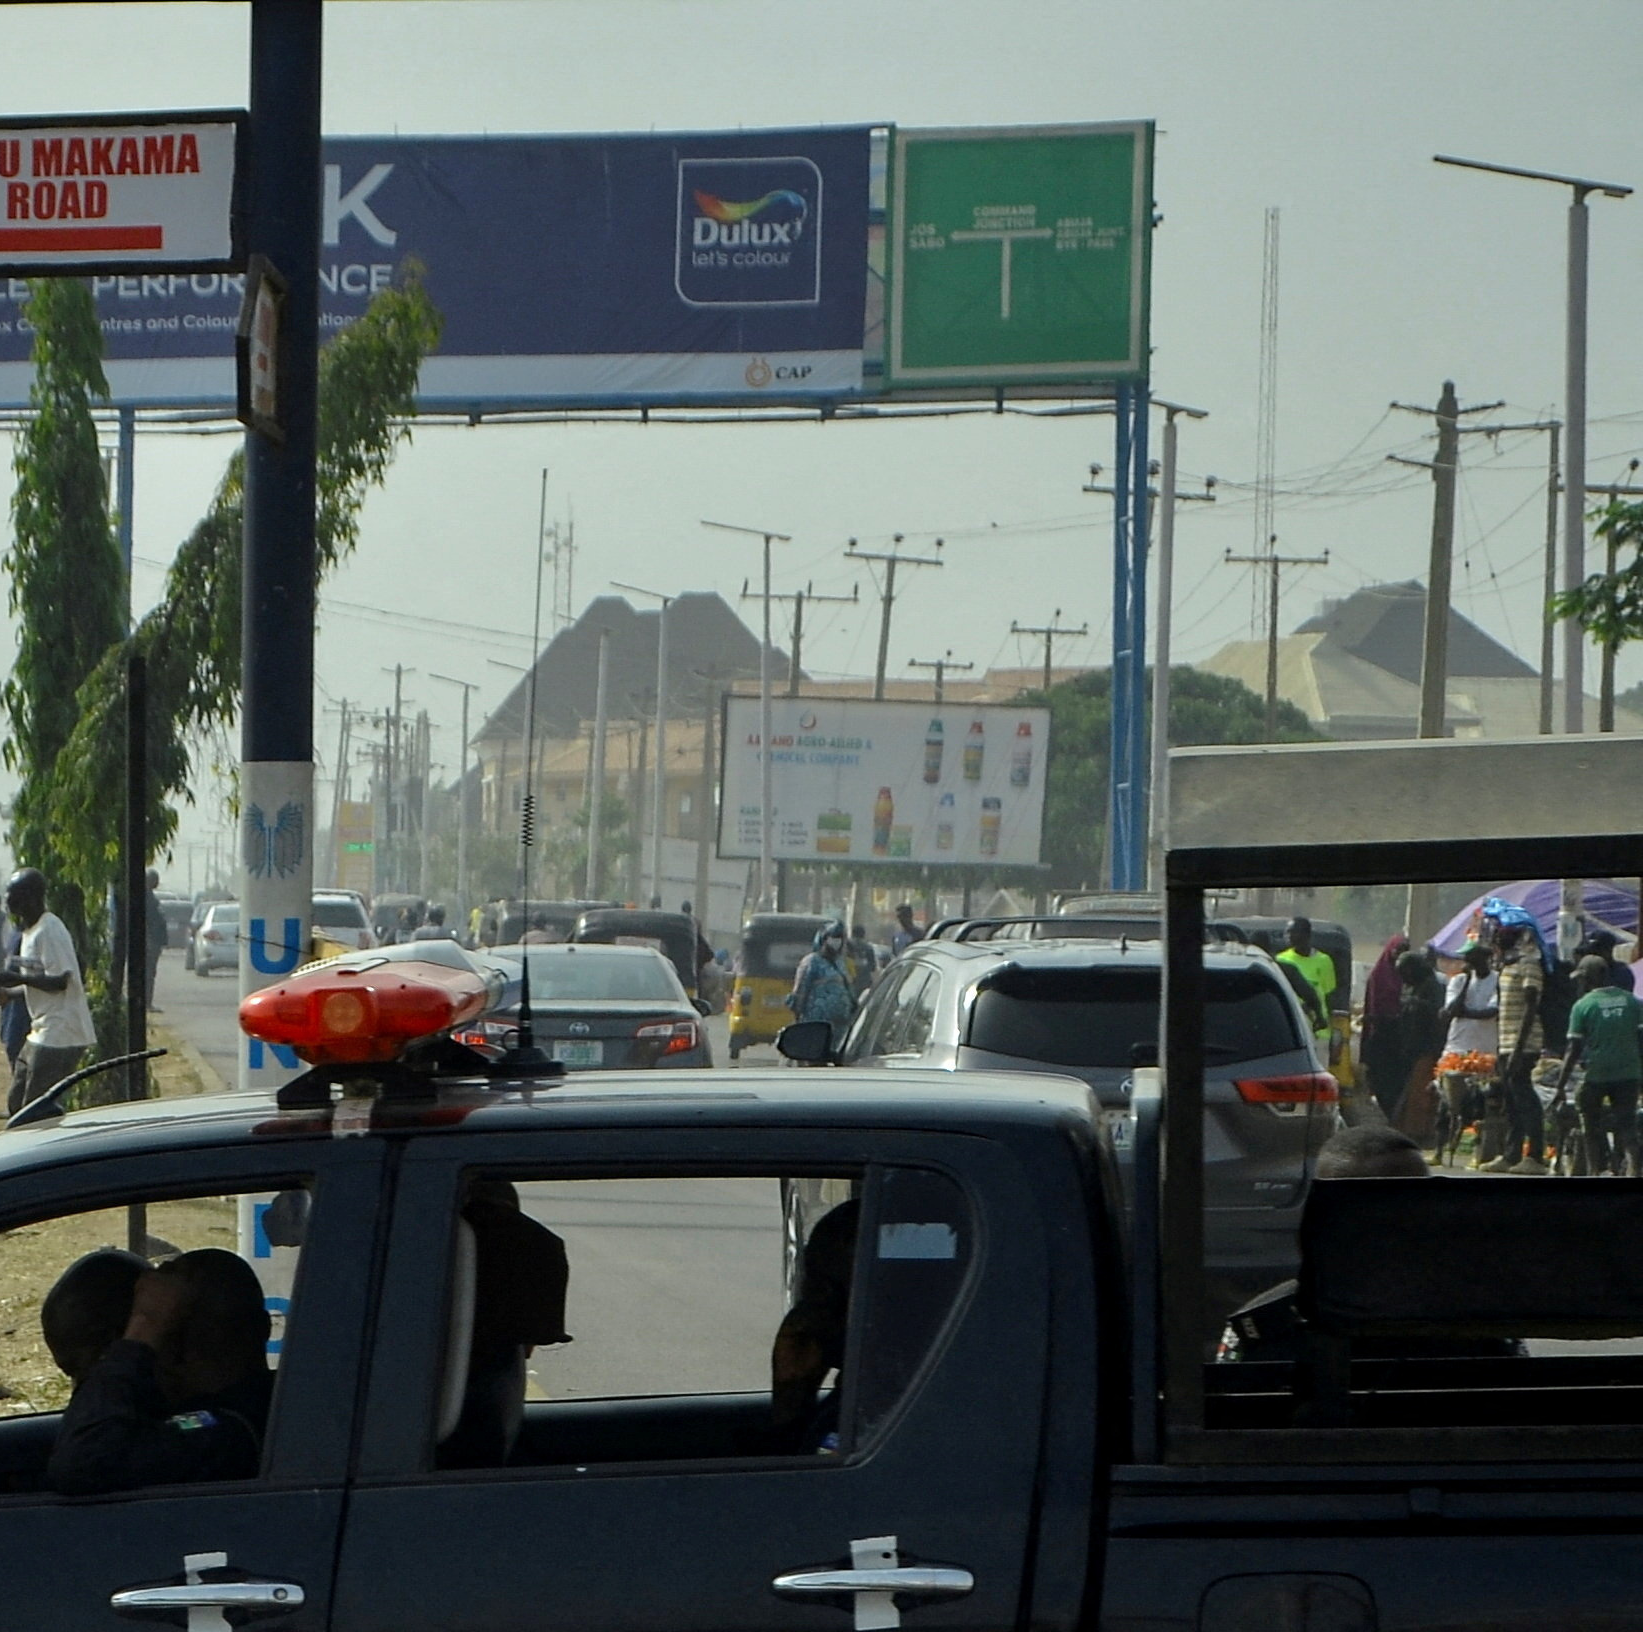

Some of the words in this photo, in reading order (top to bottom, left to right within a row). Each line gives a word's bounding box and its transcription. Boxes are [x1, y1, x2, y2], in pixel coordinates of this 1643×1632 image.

[32, 133, 200, 177] MAKAMA
[7, 180, 108, 220] ROAD
[693, 217, 791, 246] Dulux
[909, 224, 936, 236] JOS
[692, 251, 729, 266] let's
[732, 250, 791, 265] colour
[147, 314, 179, 331] and
[776, 366, 812, 379] CAP
